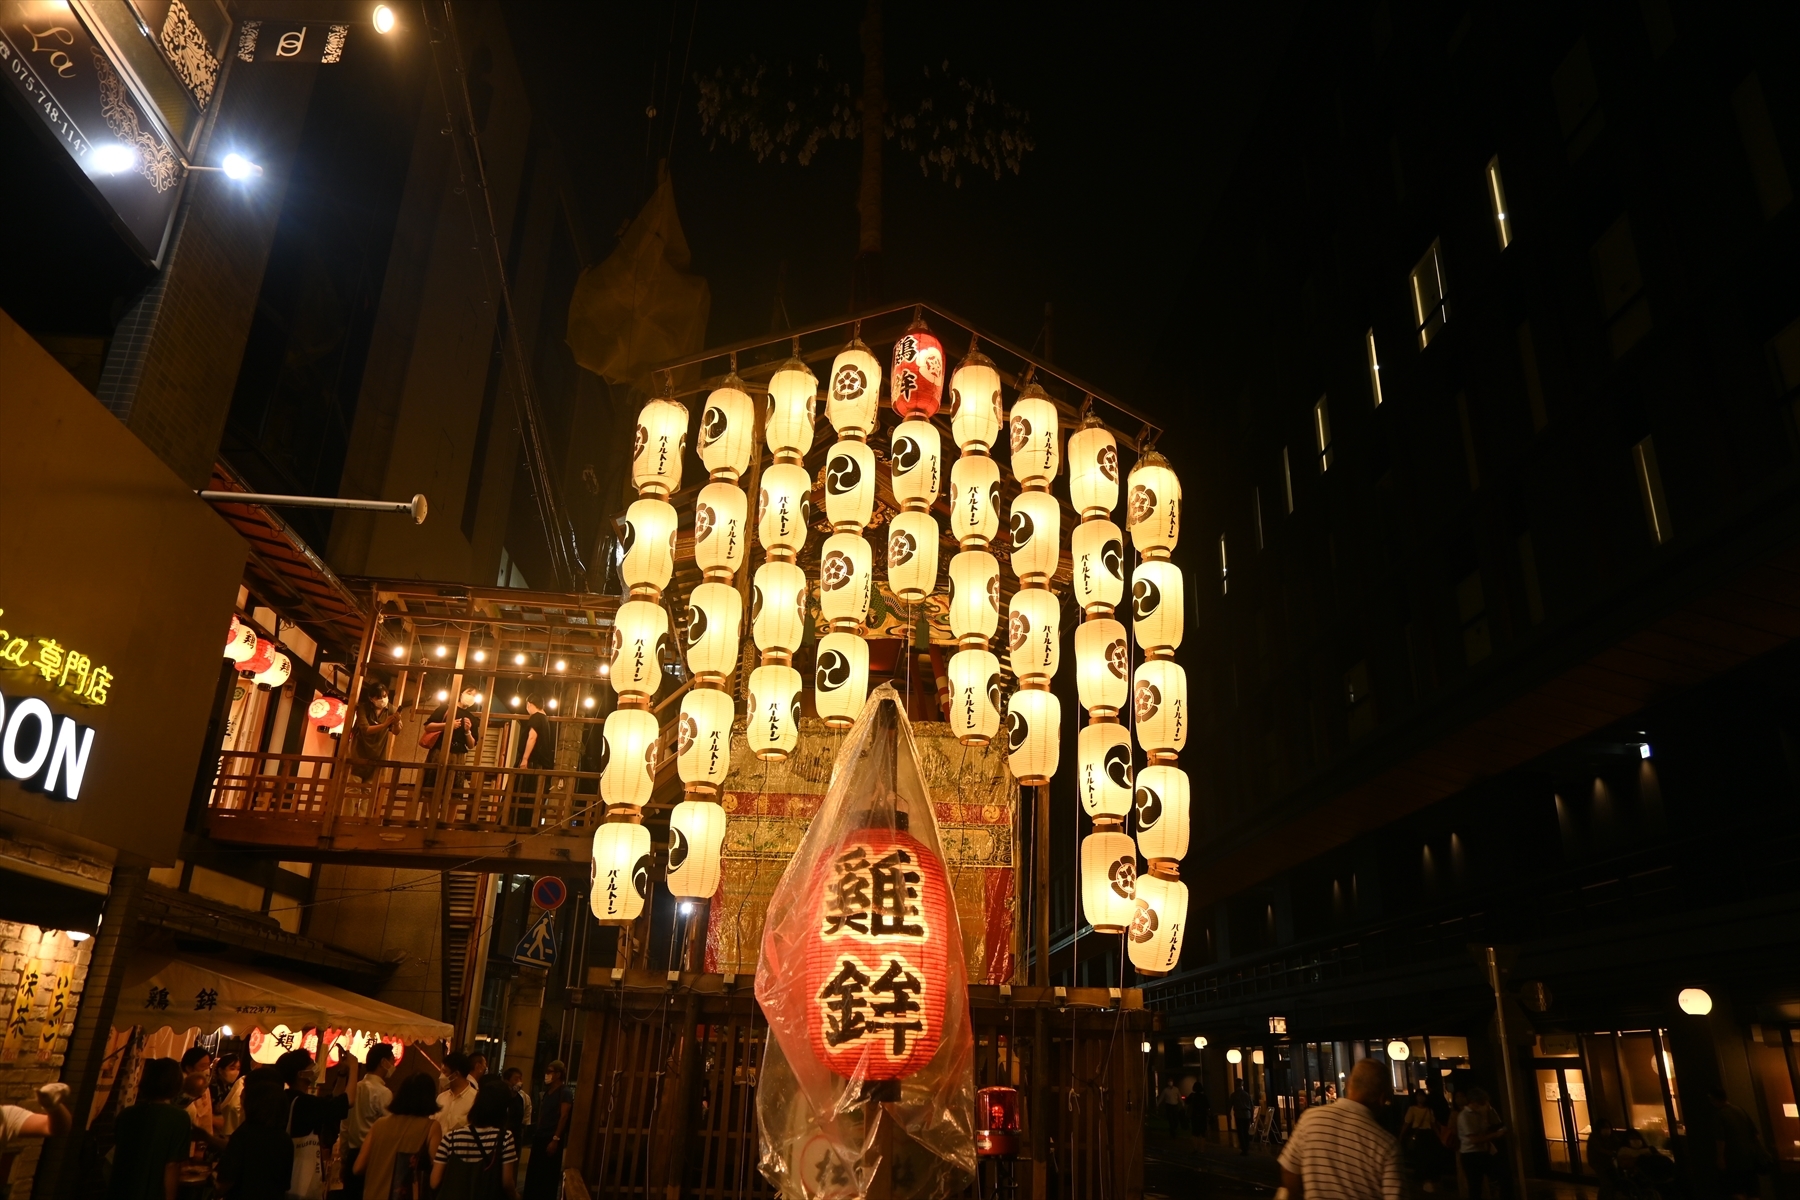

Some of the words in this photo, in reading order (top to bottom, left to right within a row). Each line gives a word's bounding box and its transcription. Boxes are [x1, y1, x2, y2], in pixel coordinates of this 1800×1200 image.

[11, 58, 87, 157] 075-748-1147
[657, 435, 669, 476] パールトーン
[1043, 430, 1054, 470] パールトーン
[929, 454, 938, 494] パールトーン
[778, 496, 790, 537] パールトーン
[967, 485, 980, 527] パールトーン
[1167, 498, 1177, 539] パールトーン
[725, 518, 737, 560] パールトーン
[1080, 553, 1093, 596] パールトーン
[634, 638, 645, 682] パールトーン
[1043, 625, 1053, 667] パールトーン
[33, 638, 114, 705] 専門店
[769, 702, 781, 742] パールトーン
[963, 686, 976, 730] パールトーン
[1173, 698, 1183, 742] パールトーン
[0, 690, 96, 801] ON
[707, 730, 721, 775] パールトーン
[1086, 763, 1098, 808] パールトーン
[607, 869, 620, 915] パールトーン
[1166, 923, 1181, 967] パールトーン
[44, 976, 69, 1043] いちご
